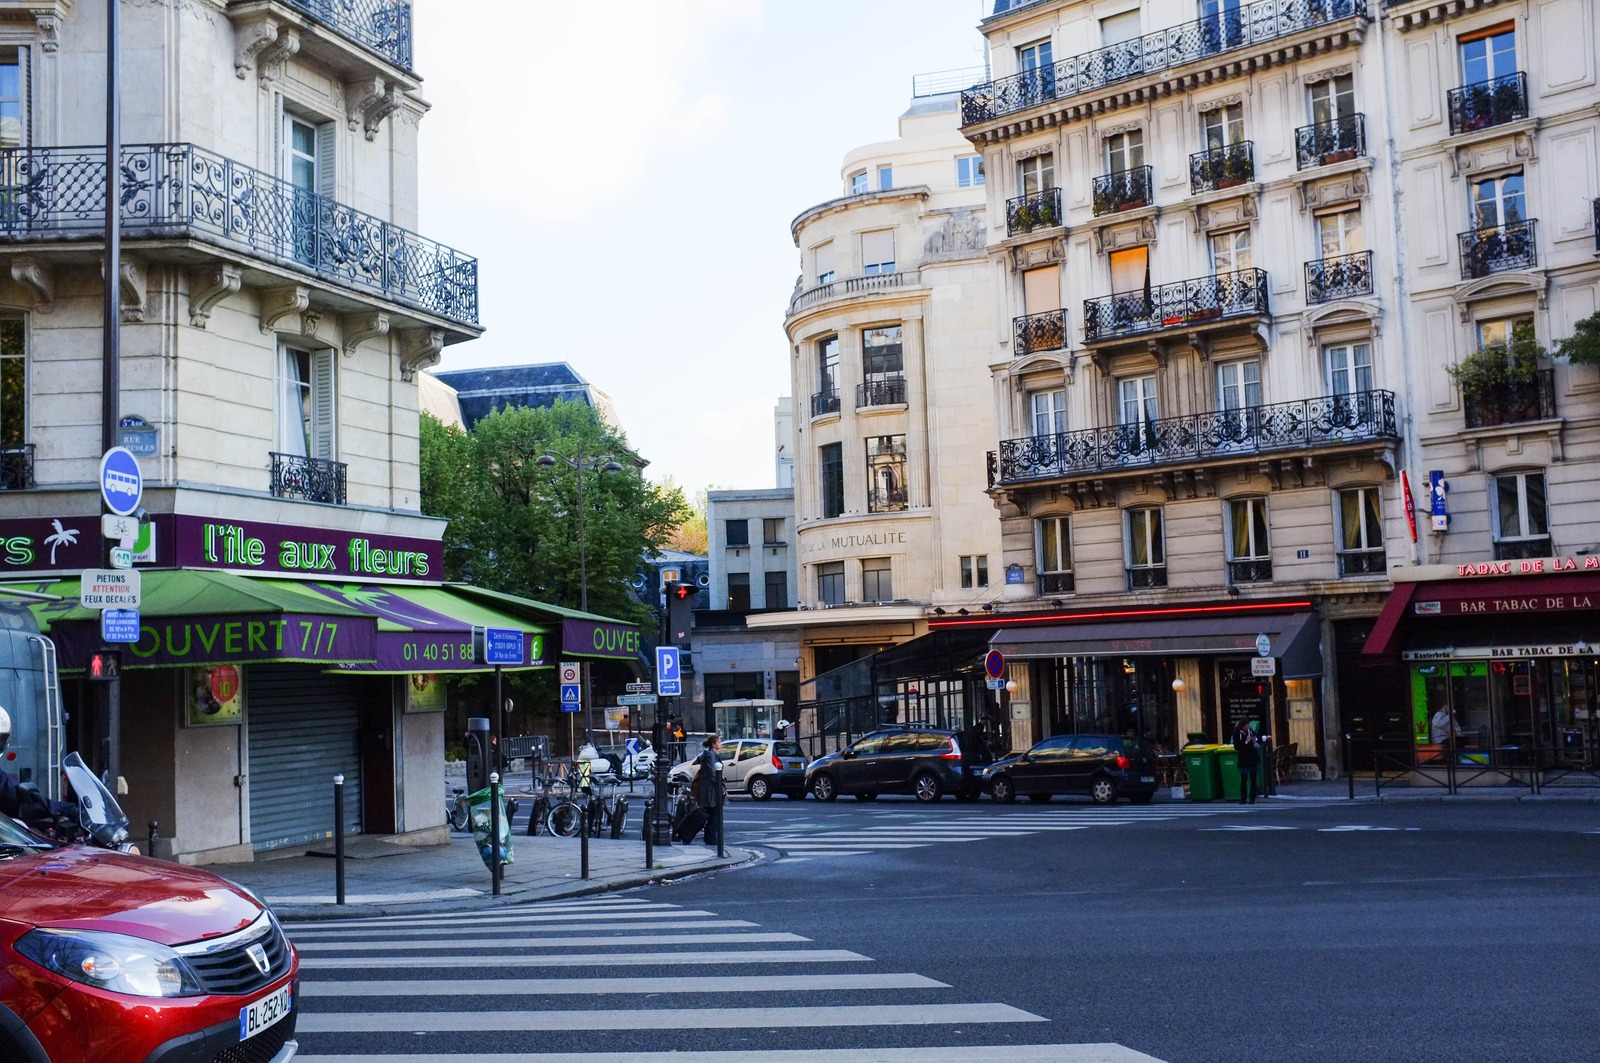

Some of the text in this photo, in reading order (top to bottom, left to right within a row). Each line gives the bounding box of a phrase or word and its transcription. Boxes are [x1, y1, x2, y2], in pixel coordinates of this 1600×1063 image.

[279, 540, 337, 570] aux
[348, 537, 430, 576] fleurs
[1457, 561, 1511, 576] TABAC
[1520, 560, 1544, 573] DE
[1553, 558, 1577, 571] LA
[96, 574, 126, 583] PIETONS
[92, 585, 130, 593] ATTENTION
[84, 595, 137, 604] FEUX DECALES
[1460, 596, 1592, 612] BAR TABAC DE LA
[129, 620, 338, 657] OUVERT 7/7
[403, 643, 473, 661] 01 40 51 88
[1491, 648, 1514, 657] BAR
[1518, 647, 1553, 656] TABAC
[1558, 646, 1574, 655] DE
[663, 653, 674, 675] P
